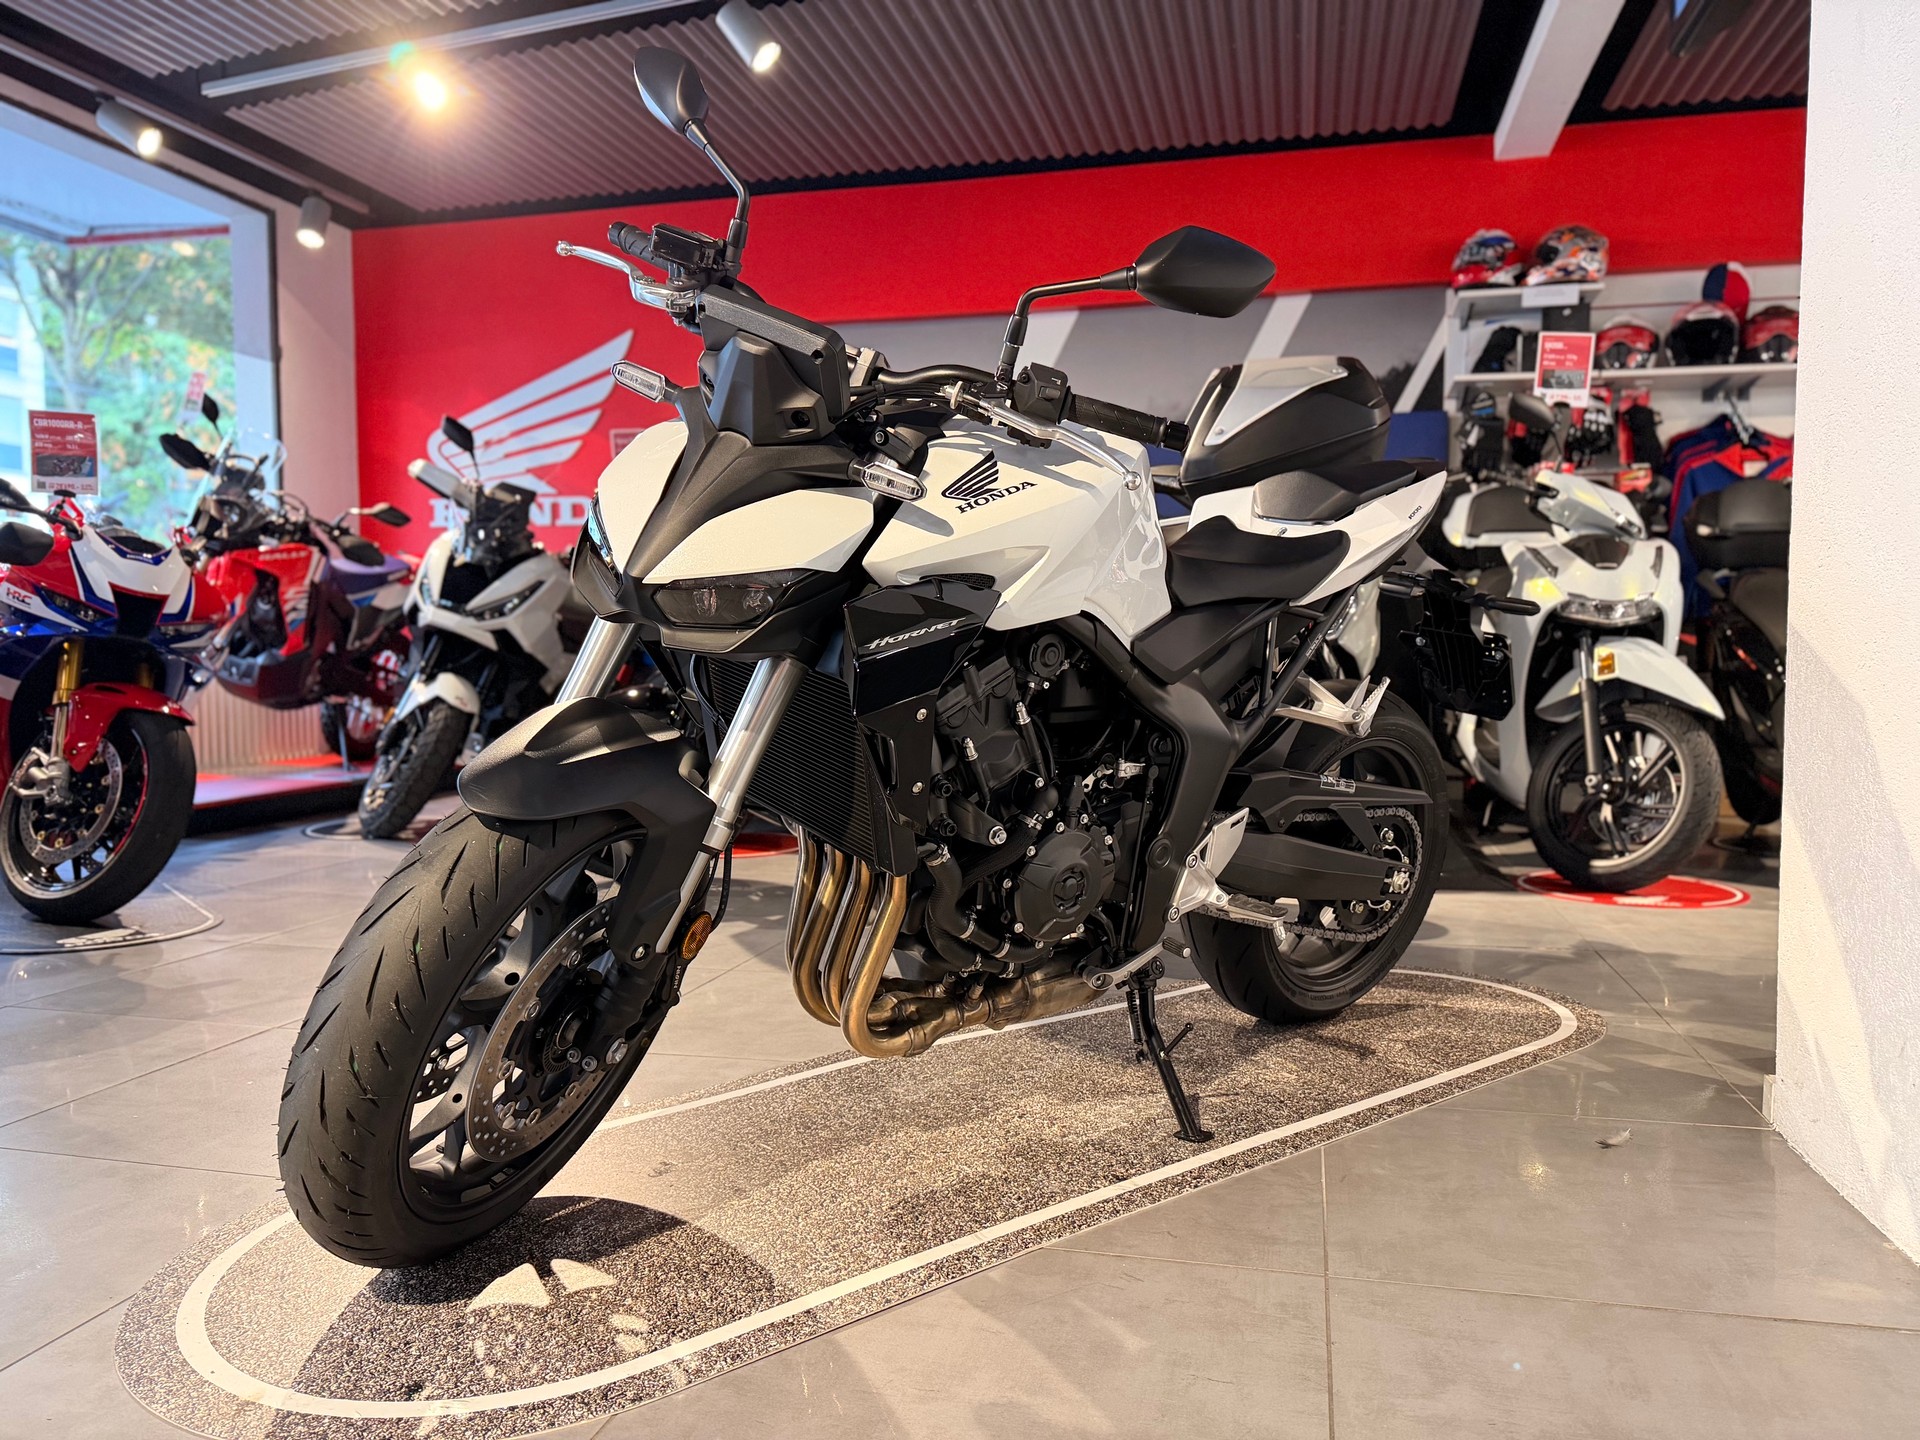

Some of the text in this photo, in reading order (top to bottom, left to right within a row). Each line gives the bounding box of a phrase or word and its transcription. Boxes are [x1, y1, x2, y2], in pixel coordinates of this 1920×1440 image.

[955, 481, 1038, 514] HONDA
[1408, 504, 1423, 520] 1000
[6, 586, 33, 605] HRC
